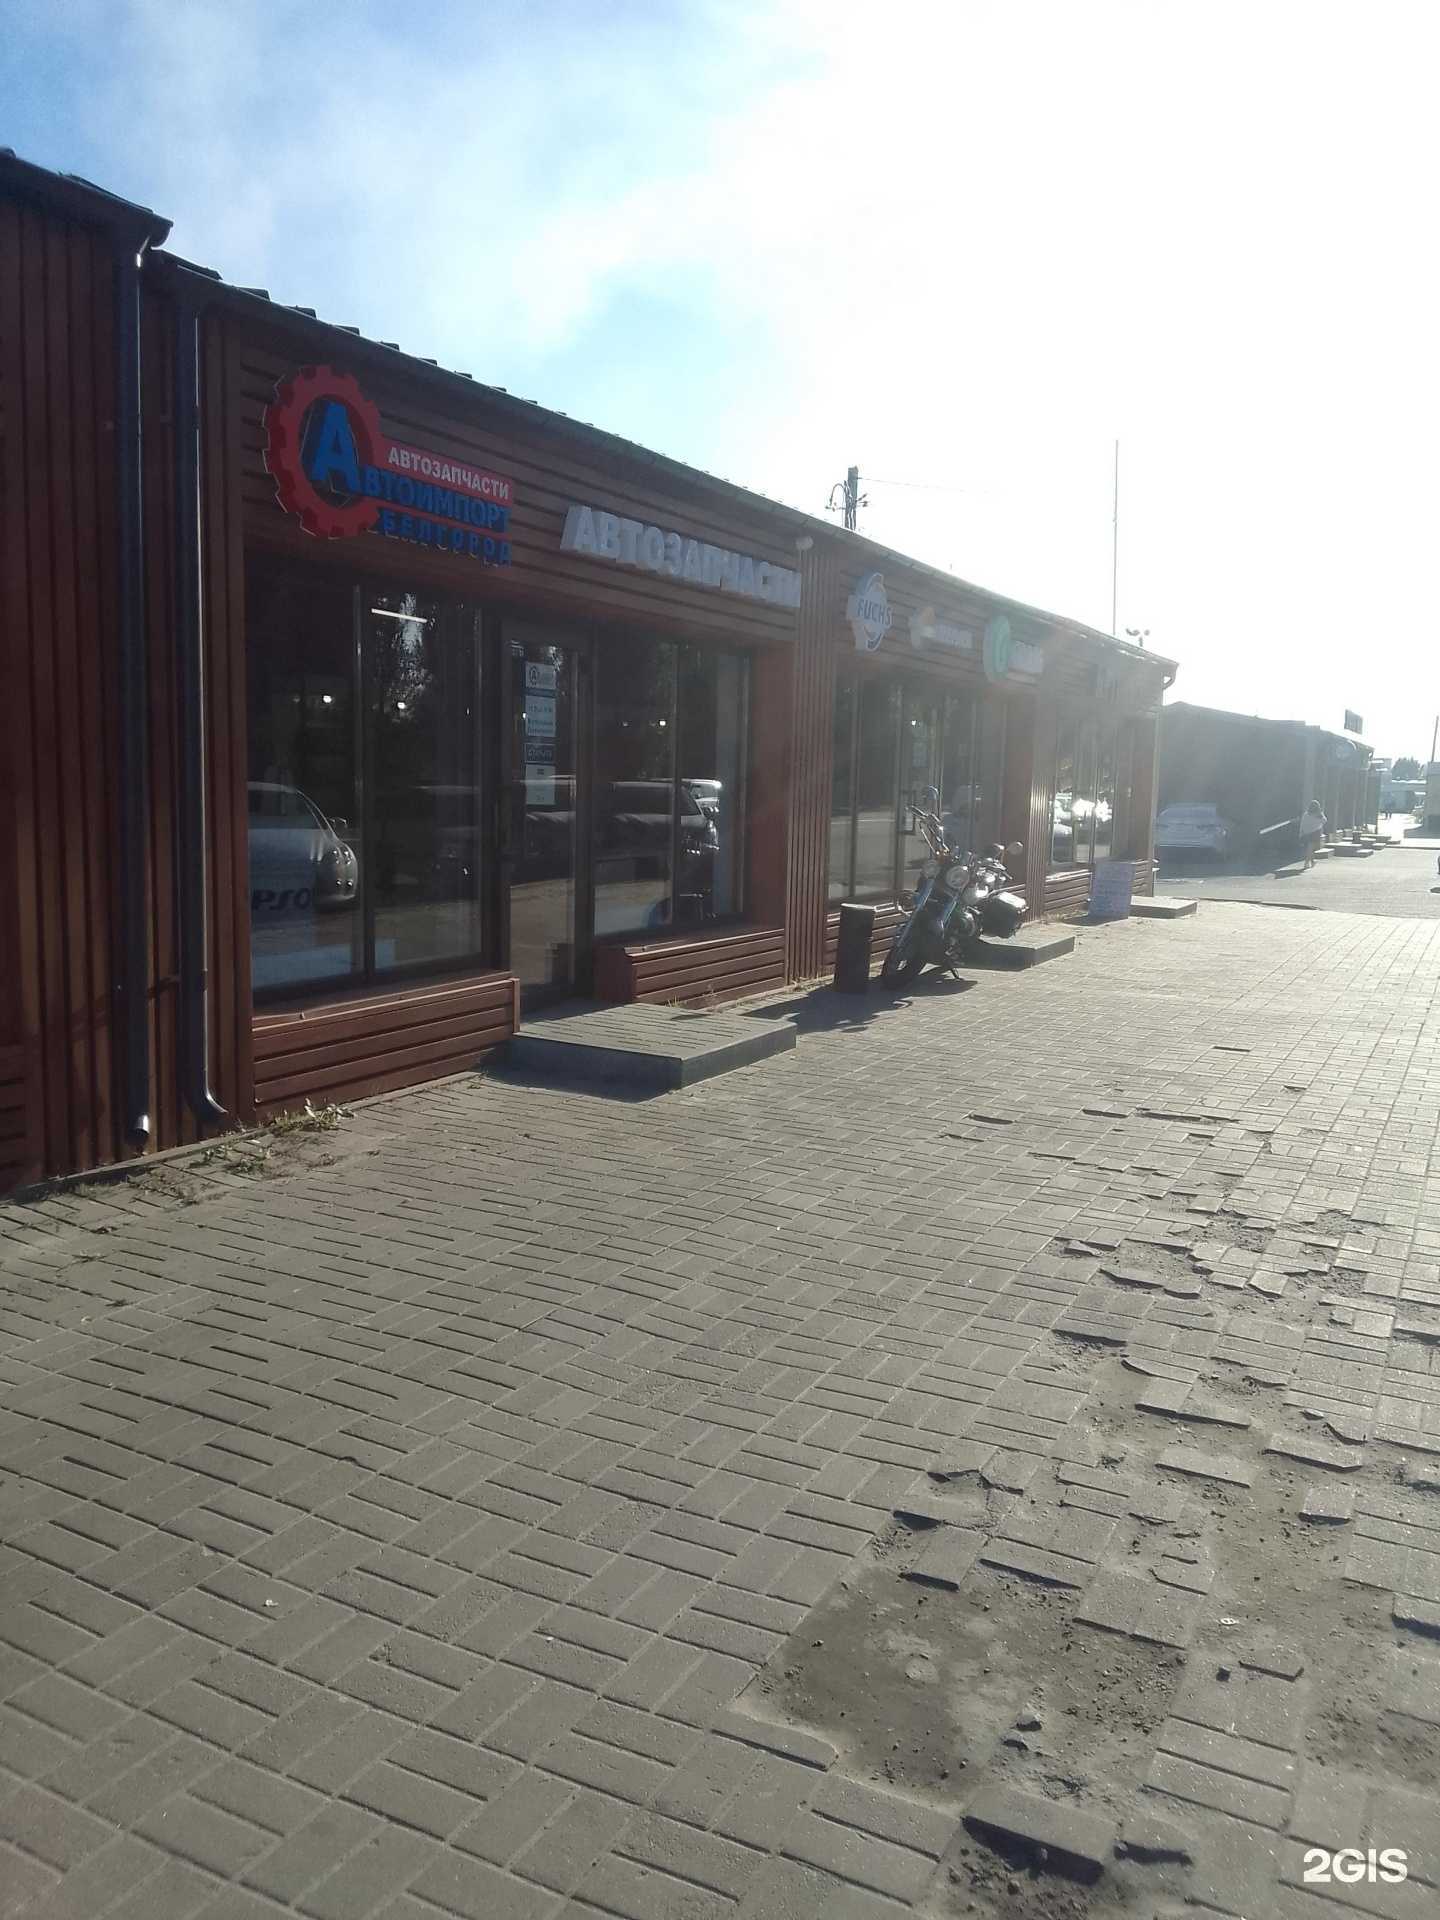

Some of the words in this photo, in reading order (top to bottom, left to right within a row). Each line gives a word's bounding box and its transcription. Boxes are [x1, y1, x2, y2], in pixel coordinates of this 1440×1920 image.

[388, 447, 509, 500] АВТОЗАПЧАСТИ
[381, 508, 512, 567] БЕЛГОРОД
[857, 599, 893, 626] FUCHS
